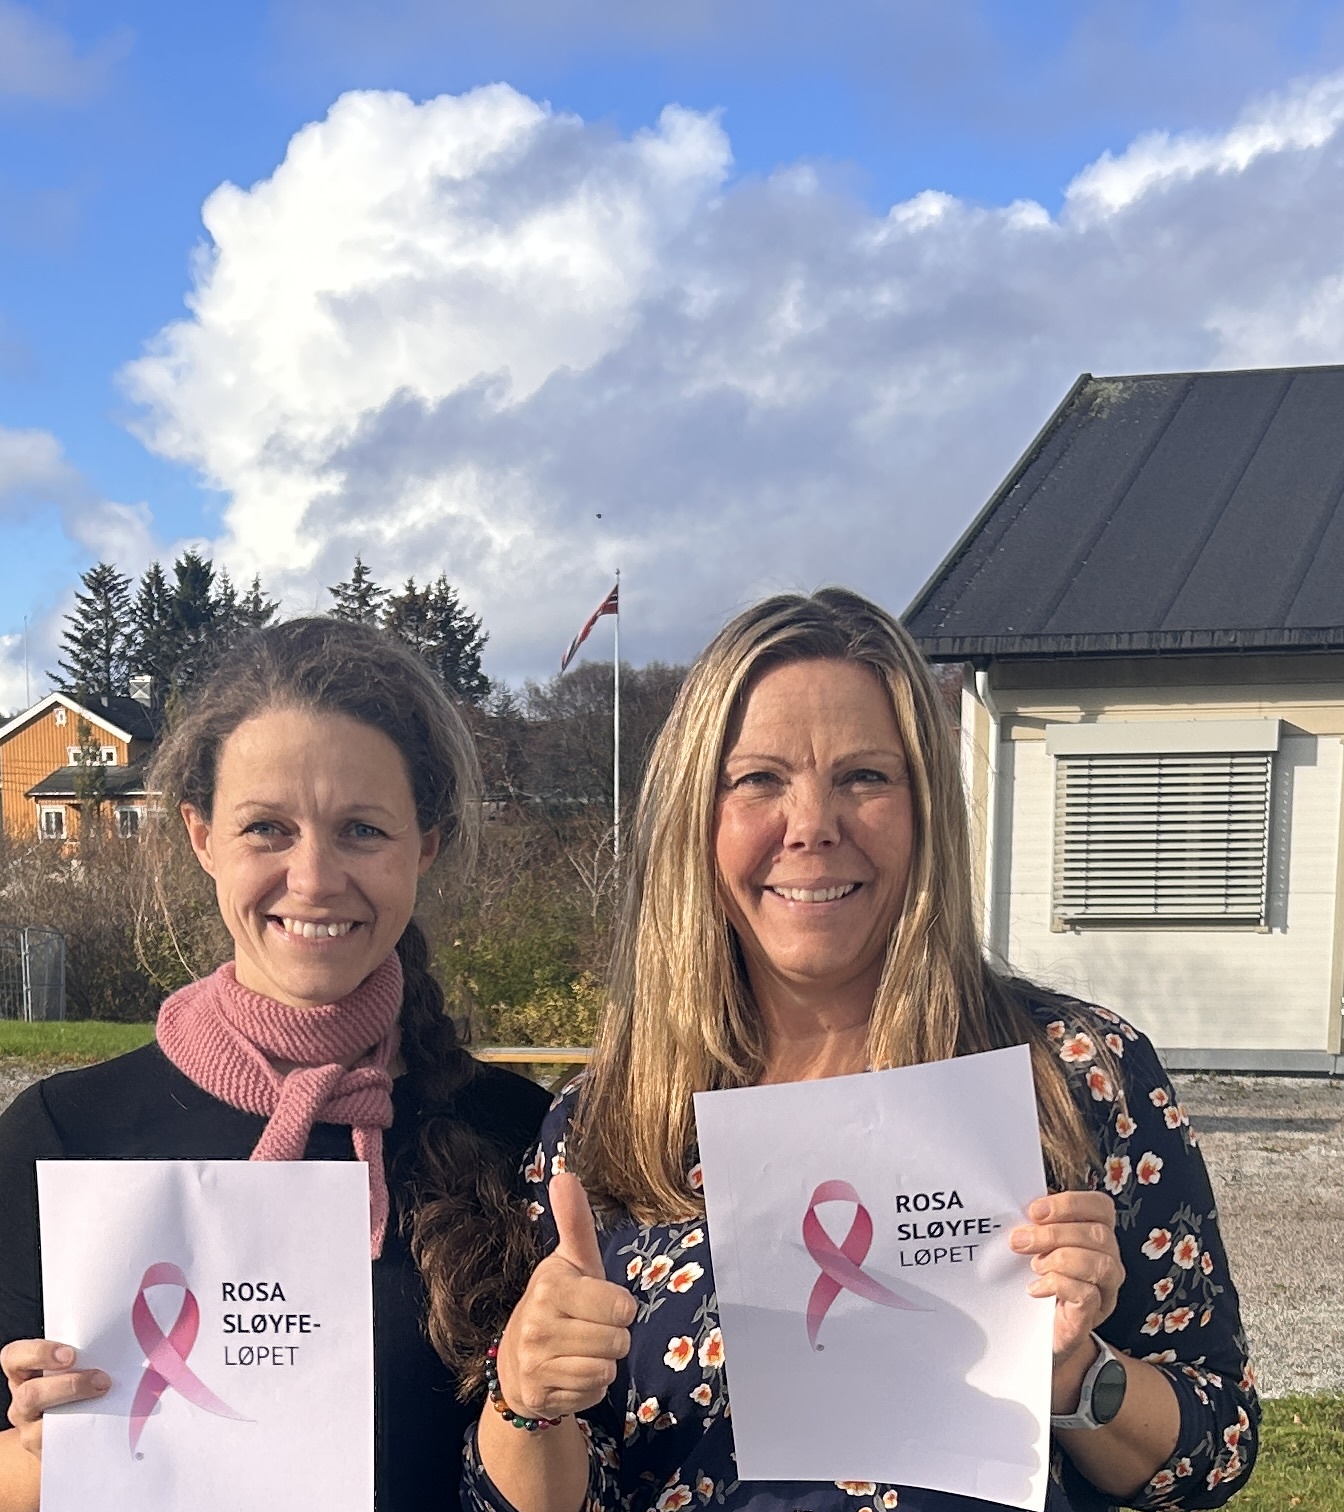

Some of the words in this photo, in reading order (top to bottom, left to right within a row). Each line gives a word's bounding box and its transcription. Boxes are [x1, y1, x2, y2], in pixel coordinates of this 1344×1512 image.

[896, 1190, 964, 1213] ROSA
[897, 1218, 1001, 1241] SLØYFE-
[900, 1244, 979, 1267] LØPET
[222, 1282, 286, 1302] ROSA
[223, 1314, 321, 1333] SLØYFE-
[225, 1346, 299, 1366] LØPET
